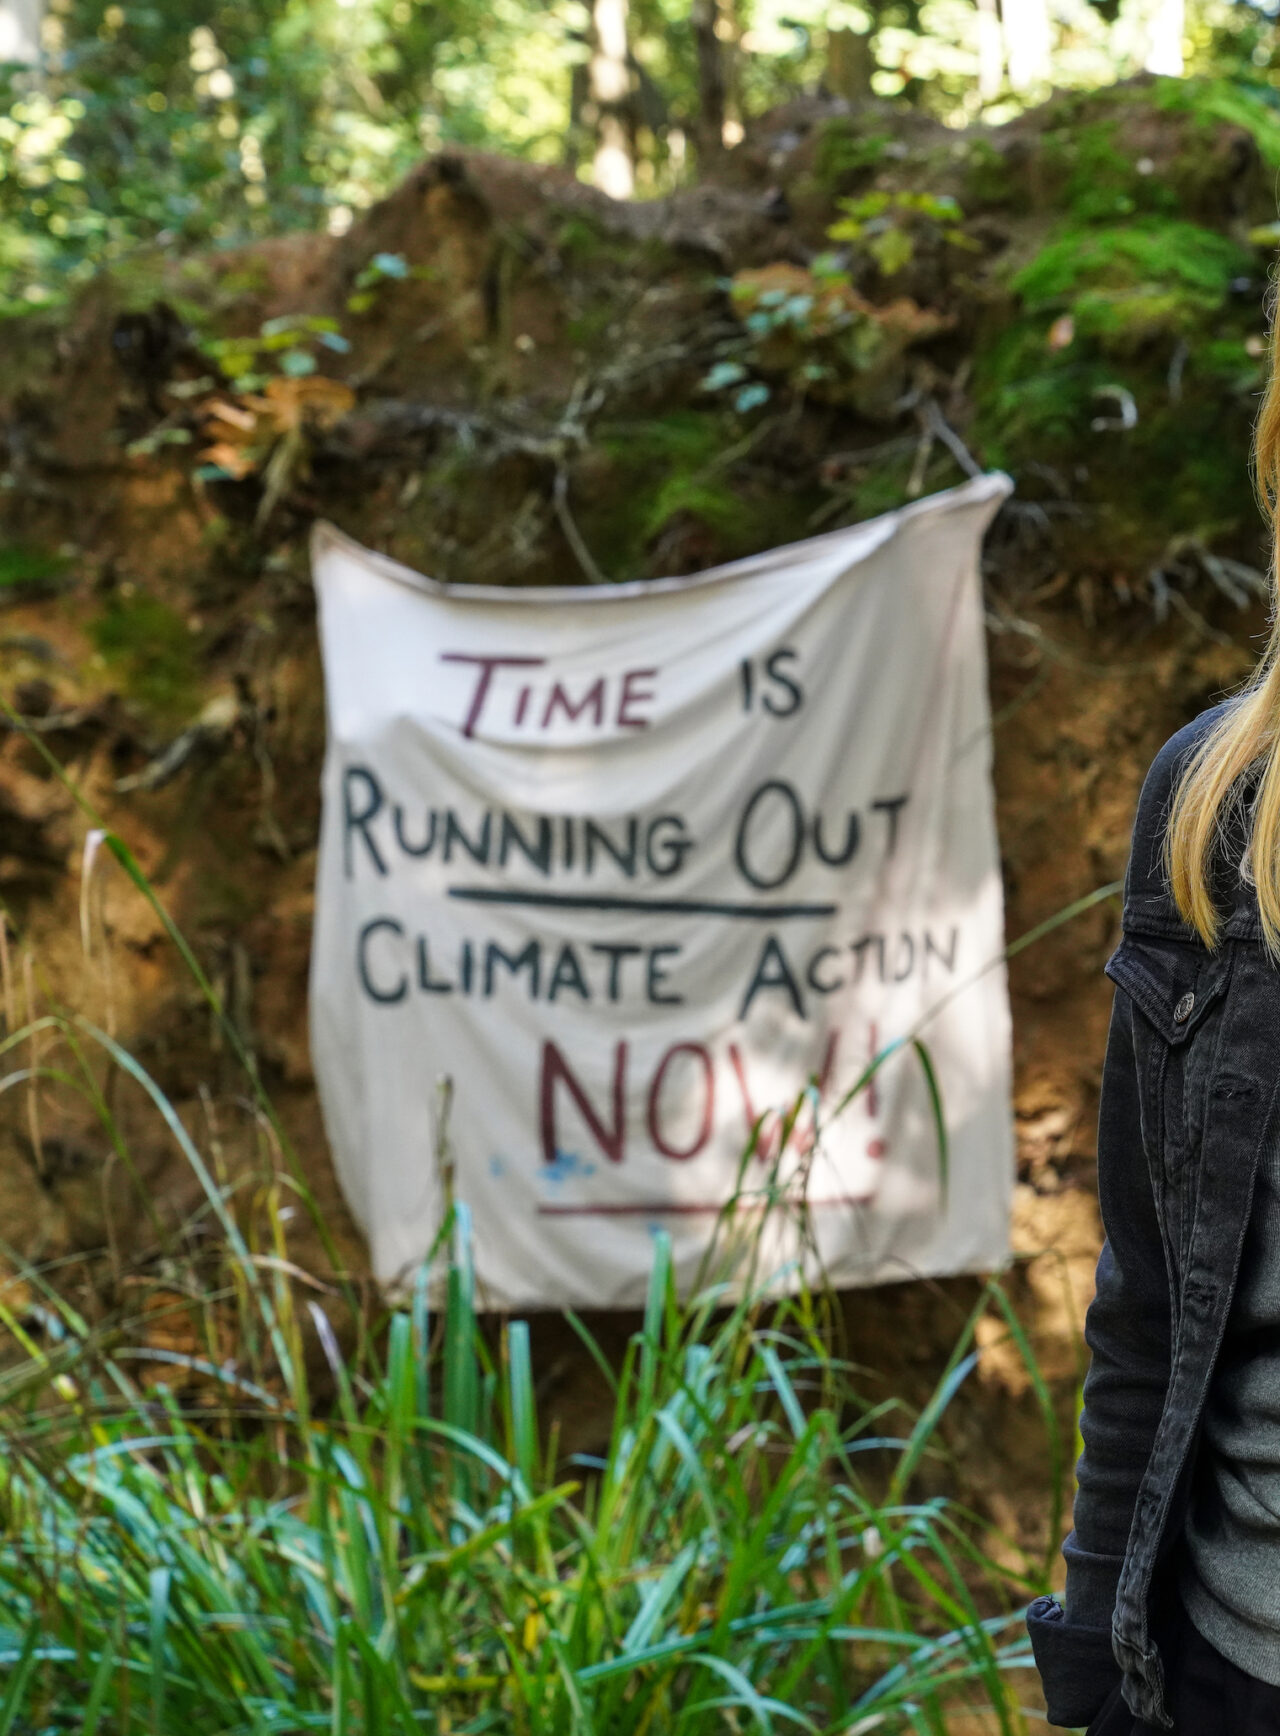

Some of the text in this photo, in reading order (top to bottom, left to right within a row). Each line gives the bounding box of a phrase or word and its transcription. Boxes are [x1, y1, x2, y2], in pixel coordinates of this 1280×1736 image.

[740, 648, 803, 718] IS
[342, 766, 907, 890] RUNNING OUT
[357, 917, 959, 1021] CLIMATE ACTION
